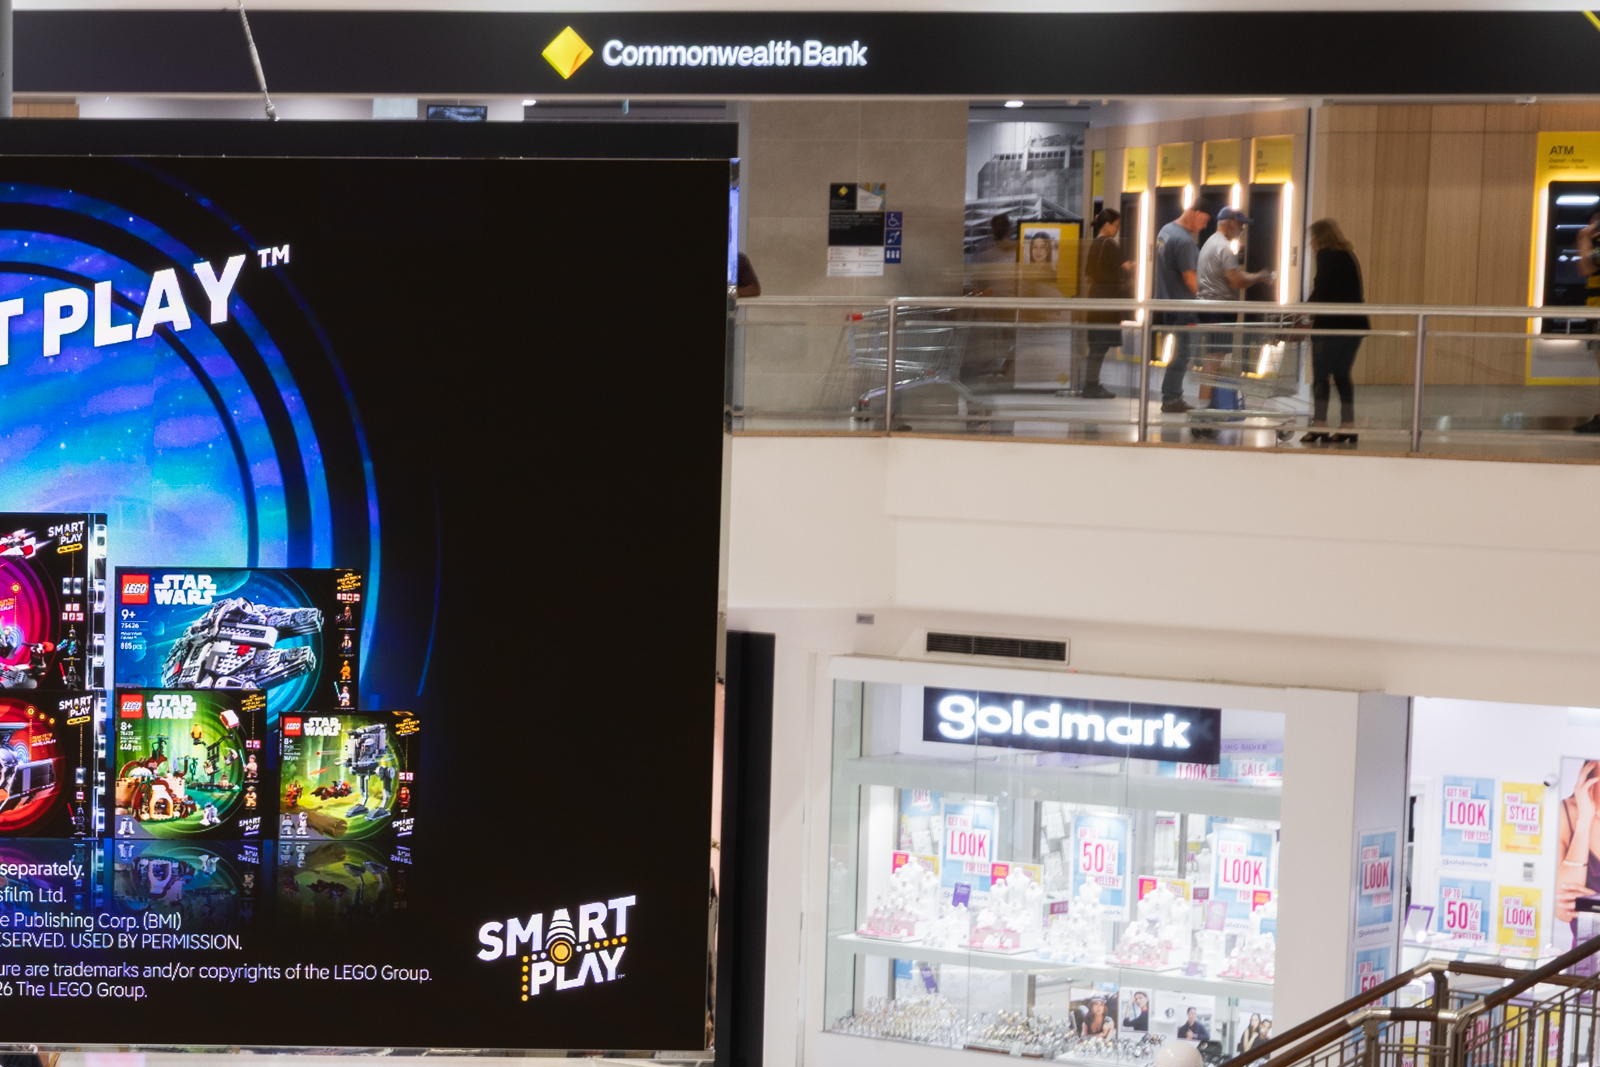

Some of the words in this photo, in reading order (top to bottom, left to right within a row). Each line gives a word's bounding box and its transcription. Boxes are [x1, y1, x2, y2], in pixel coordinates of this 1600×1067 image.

[1549, 145, 1575, 156] ATM
[47, 520, 86, 538] SMART
[60, 529, 84, 546] PLAY
[123, 582, 149, 595] LEGO
[154, 574, 218, 590] STAR
[154, 589, 217, 606] WARS
[120, 608, 136, 621] 9+
[59, 695, 94, 711] SMART
[122, 701, 142, 712] LEGO
[146, 694, 198, 708] STAR
[69, 706, 92, 719] PLAY
[146, 706, 198, 720] WARS
[120, 721, 133, 731] 8+
[304, 717, 342, 728] STAR
[304, 726, 342, 737] WARS
[1241, 762, 1266, 778] SALE
[1446, 788, 1457, 798] GET
[1458, 788, 1470, 799] THE
[947, 815, 959, 827] GET
[1449, 801, 1487, 827] LOOK
[1509, 805, 1537, 822] STYLE
[950, 830, 988, 859] LOOK
[1464, 831, 1475, 841] FOR
[1476, 832, 1490, 842] LESS
[1082, 841, 1105, 873] 50
[0, 860, 85, 881] separately.
[976, 863, 990, 875] LESS
[1223, 857, 1263, 886] LOOK
[1363, 860, 1391, 890] LOOK
[39, 887, 67, 903] Ltd.
[1443, 889, 1453, 899] UP
[1453, 889, 1462, 899] TO
[14, 912, 94, 931] Publishing
[99, 913, 140, 932] Corp.
[144, 912, 182, 931] (BMI)
[1447, 900, 1469, 930] 50
[1506, 908, 1533, 927] LOOK
[477, 895, 636, 961] SMART
[71, 933, 114, 949] USED
[118, 933, 139, 949] BY
[142, 934, 243, 950] PERMISSION.
[25, 964, 50, 977] are
[54, 961, 139, 978] trademarks
[143, 962, 195, 982] and/or
[199, 962, 281, 983] copyrights
[285, 964, 302, 980] of
[305, 964, 330, 980] the
[334, 965, 378, 981] LEGO
[381, 965, 433, 985] Group.
[531, 946, 626, 996] PLAY
[16, 982, 46, 997] The
[49, 982, 93, 998] LEGO
[97, 982, 148, 1001] Group.
